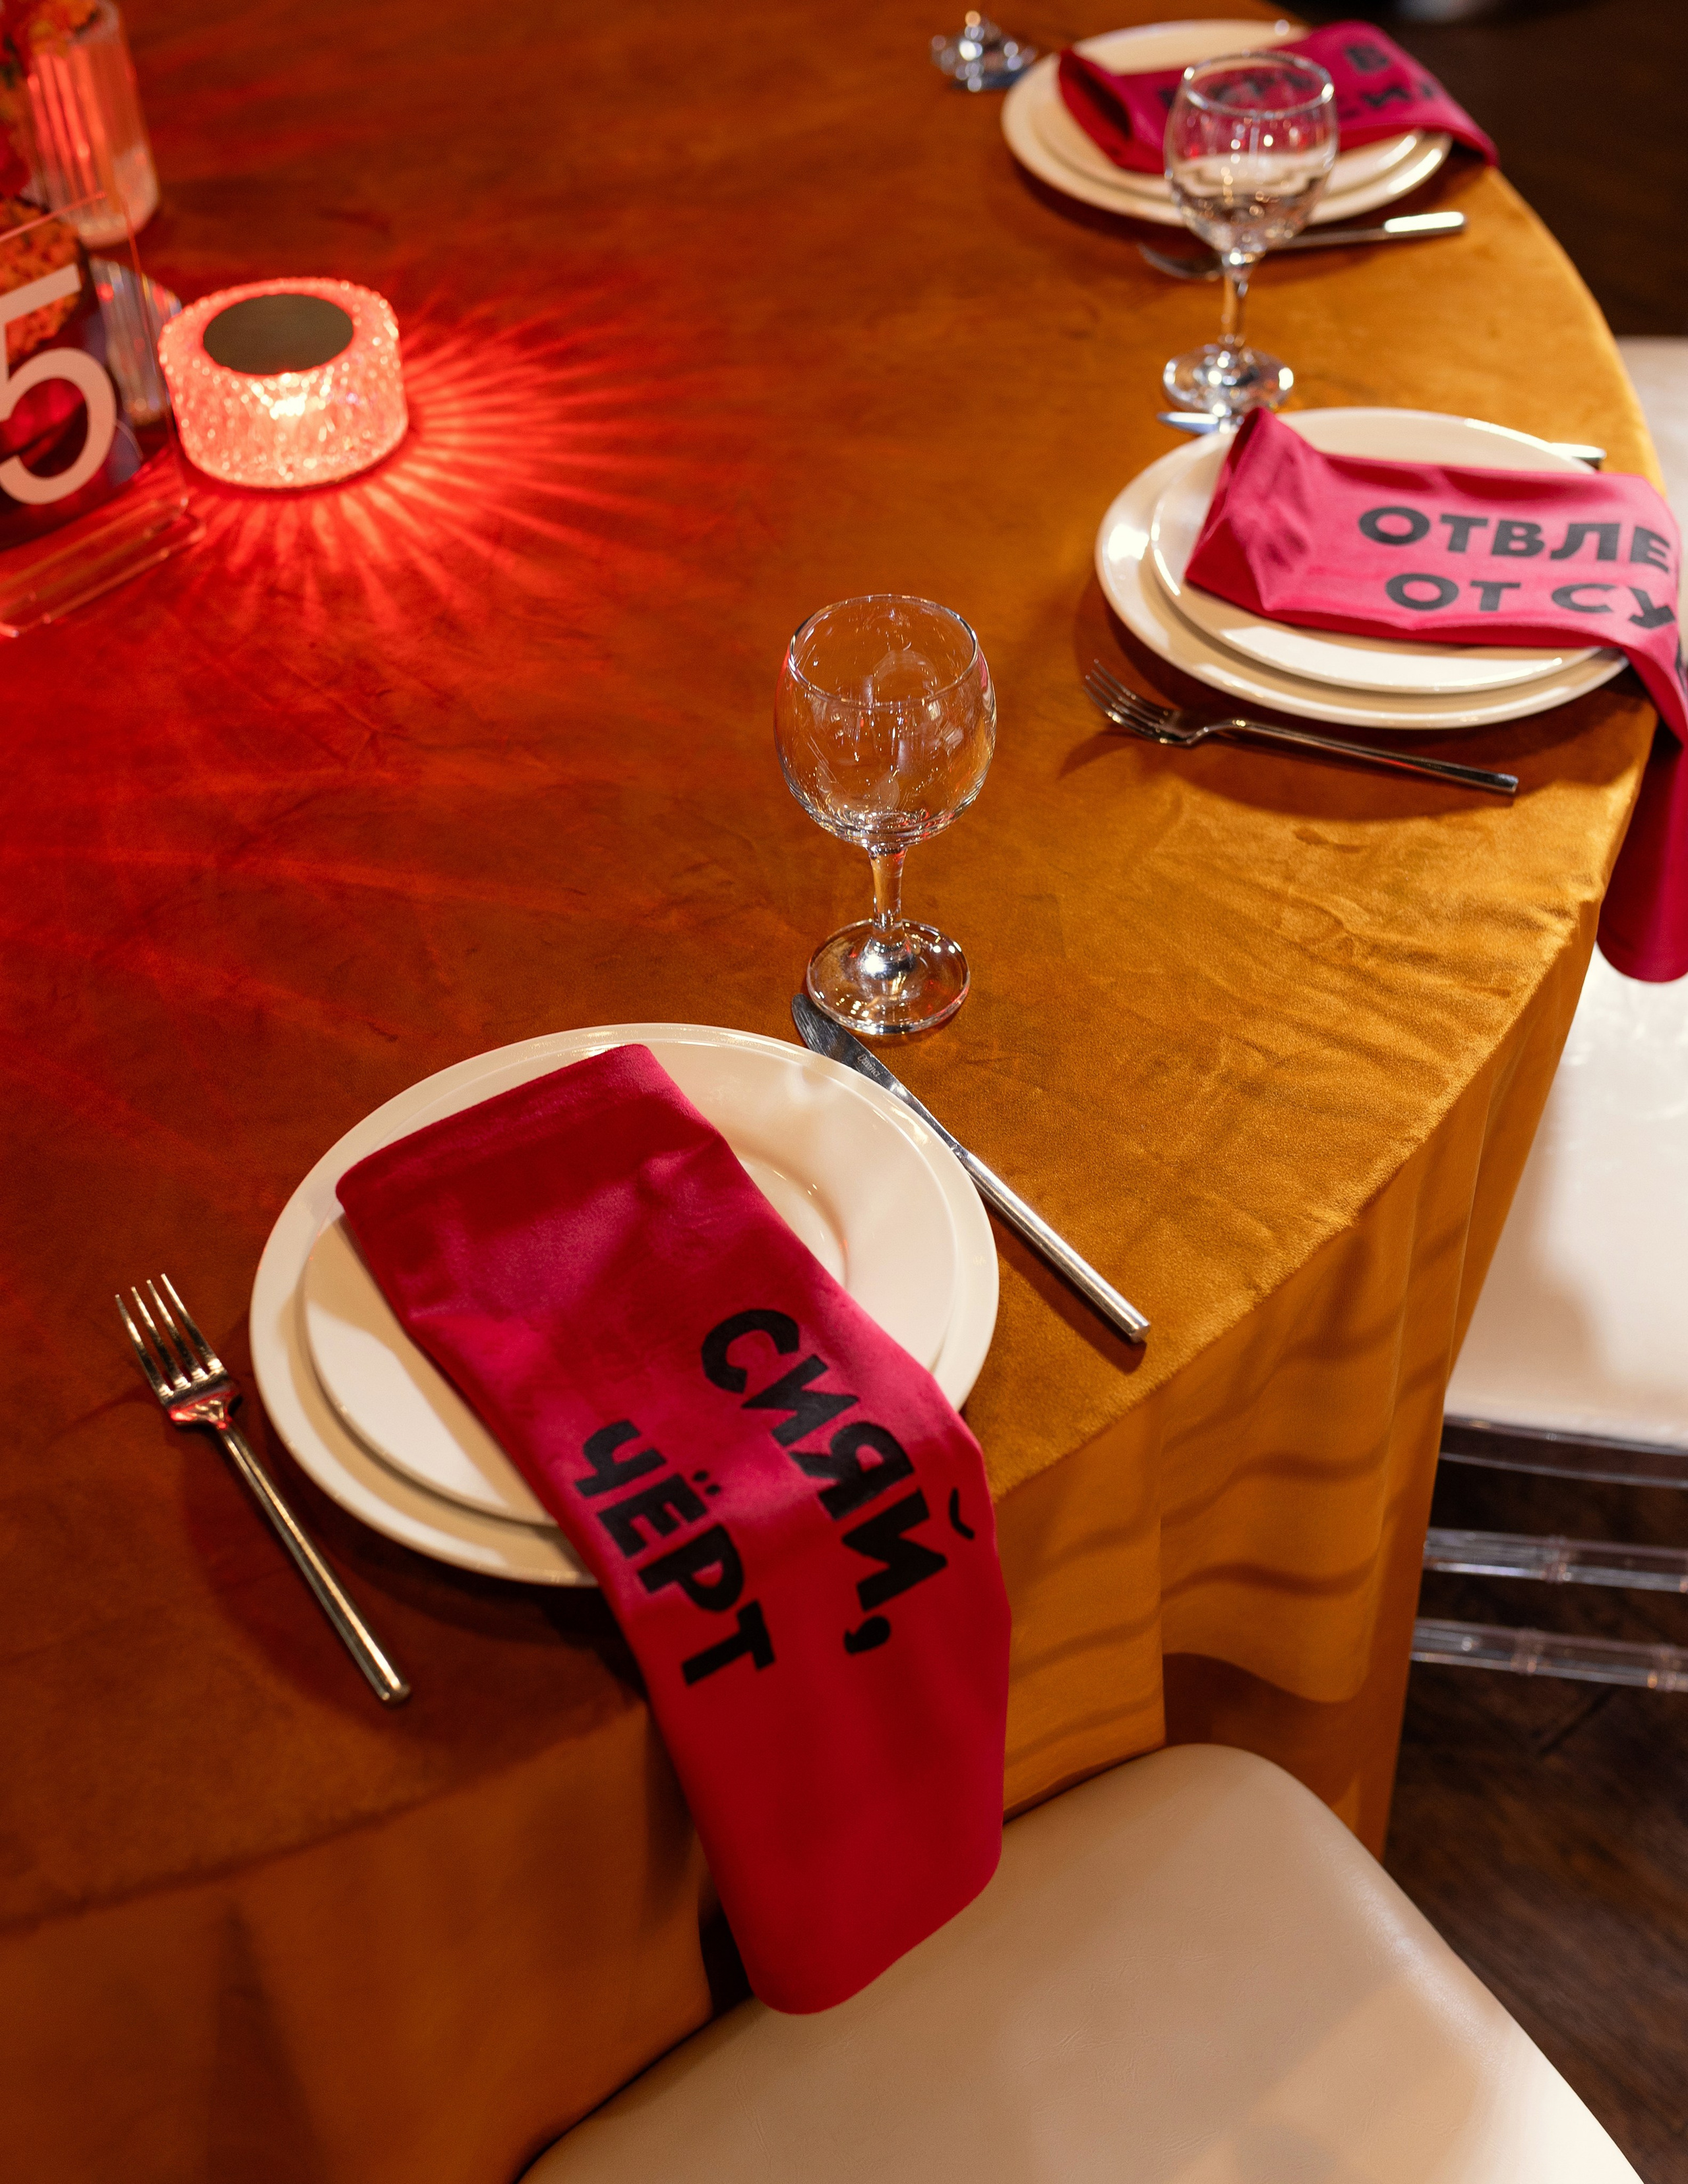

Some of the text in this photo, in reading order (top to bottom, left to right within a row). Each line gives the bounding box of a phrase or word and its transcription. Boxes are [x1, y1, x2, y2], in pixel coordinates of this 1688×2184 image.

[0, 264, 117, 504] 5
[1358, 506, 1671, 574] ОТВЛЕ
[1385, 573, 1675, 630] ОТ СУ
[574, 1419, 776, 1687] ЧЁРТ
[700, 1309, 975, 1655] СИЯЙ,
